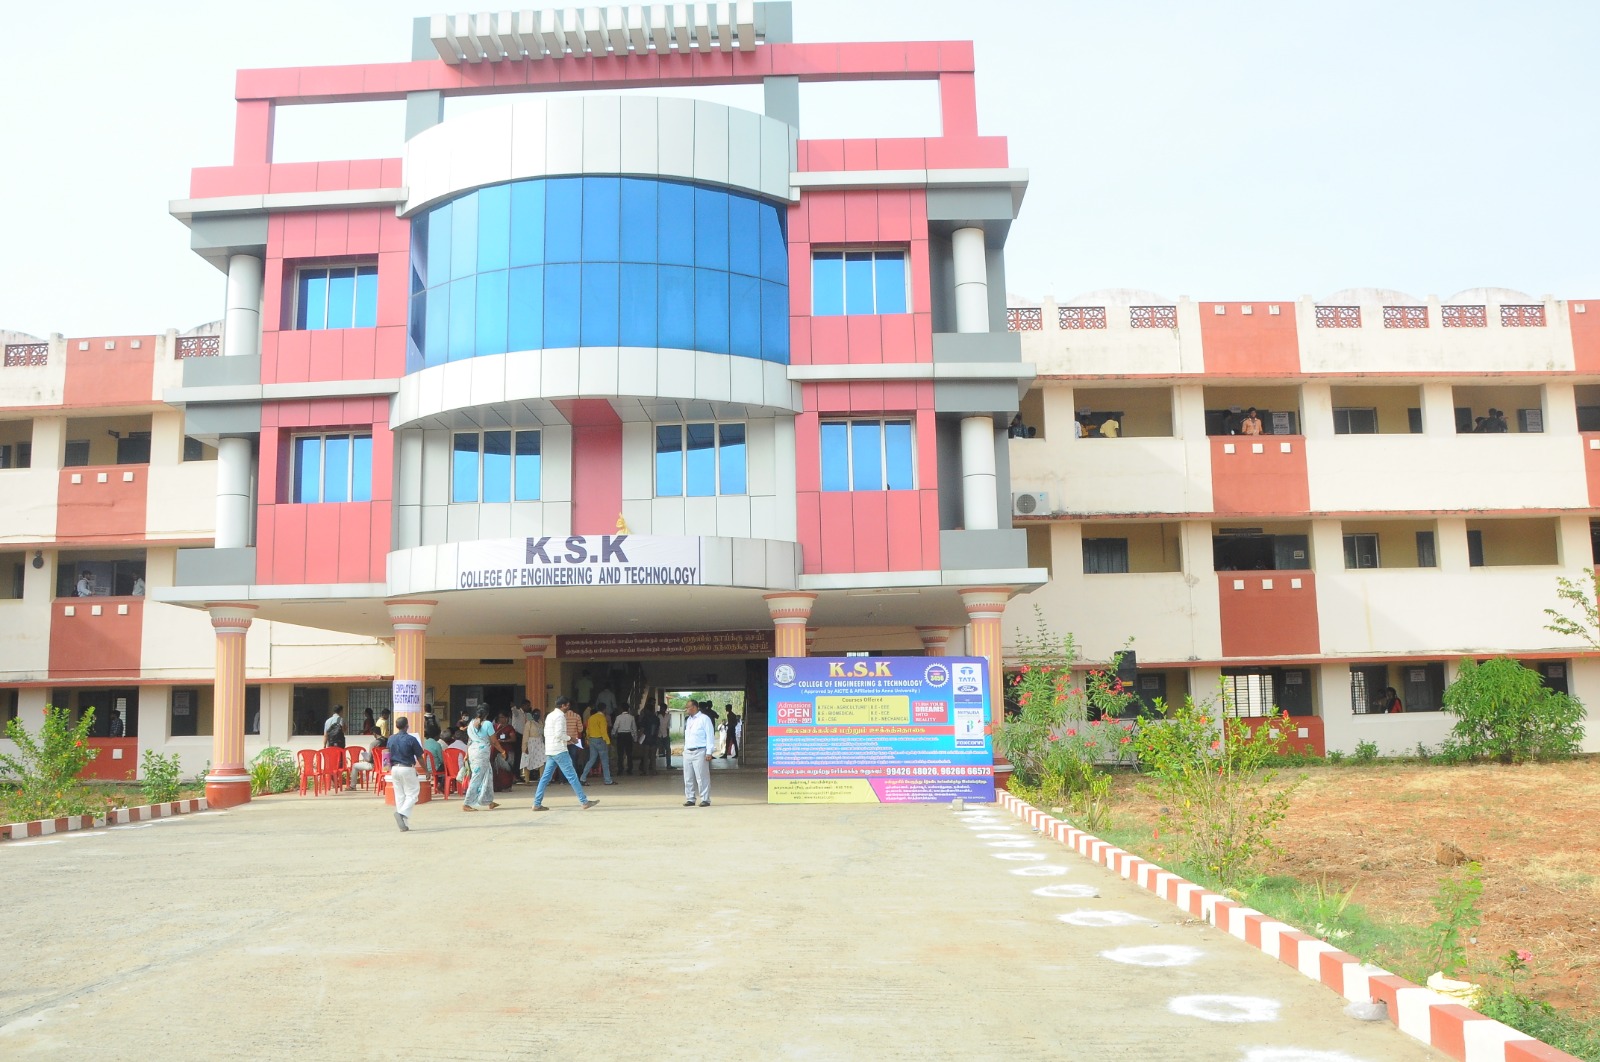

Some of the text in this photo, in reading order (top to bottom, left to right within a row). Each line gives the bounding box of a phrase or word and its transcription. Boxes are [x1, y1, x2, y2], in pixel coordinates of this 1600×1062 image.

[526, 535, 629, 564] K.S.K
[460, 566, 696, 588] COLLEGE OF ENGINEERING AND TECHNOLOGY
[829, 662, 893, 678] K.S.K
[778, 709, 810, 718] OPEN
